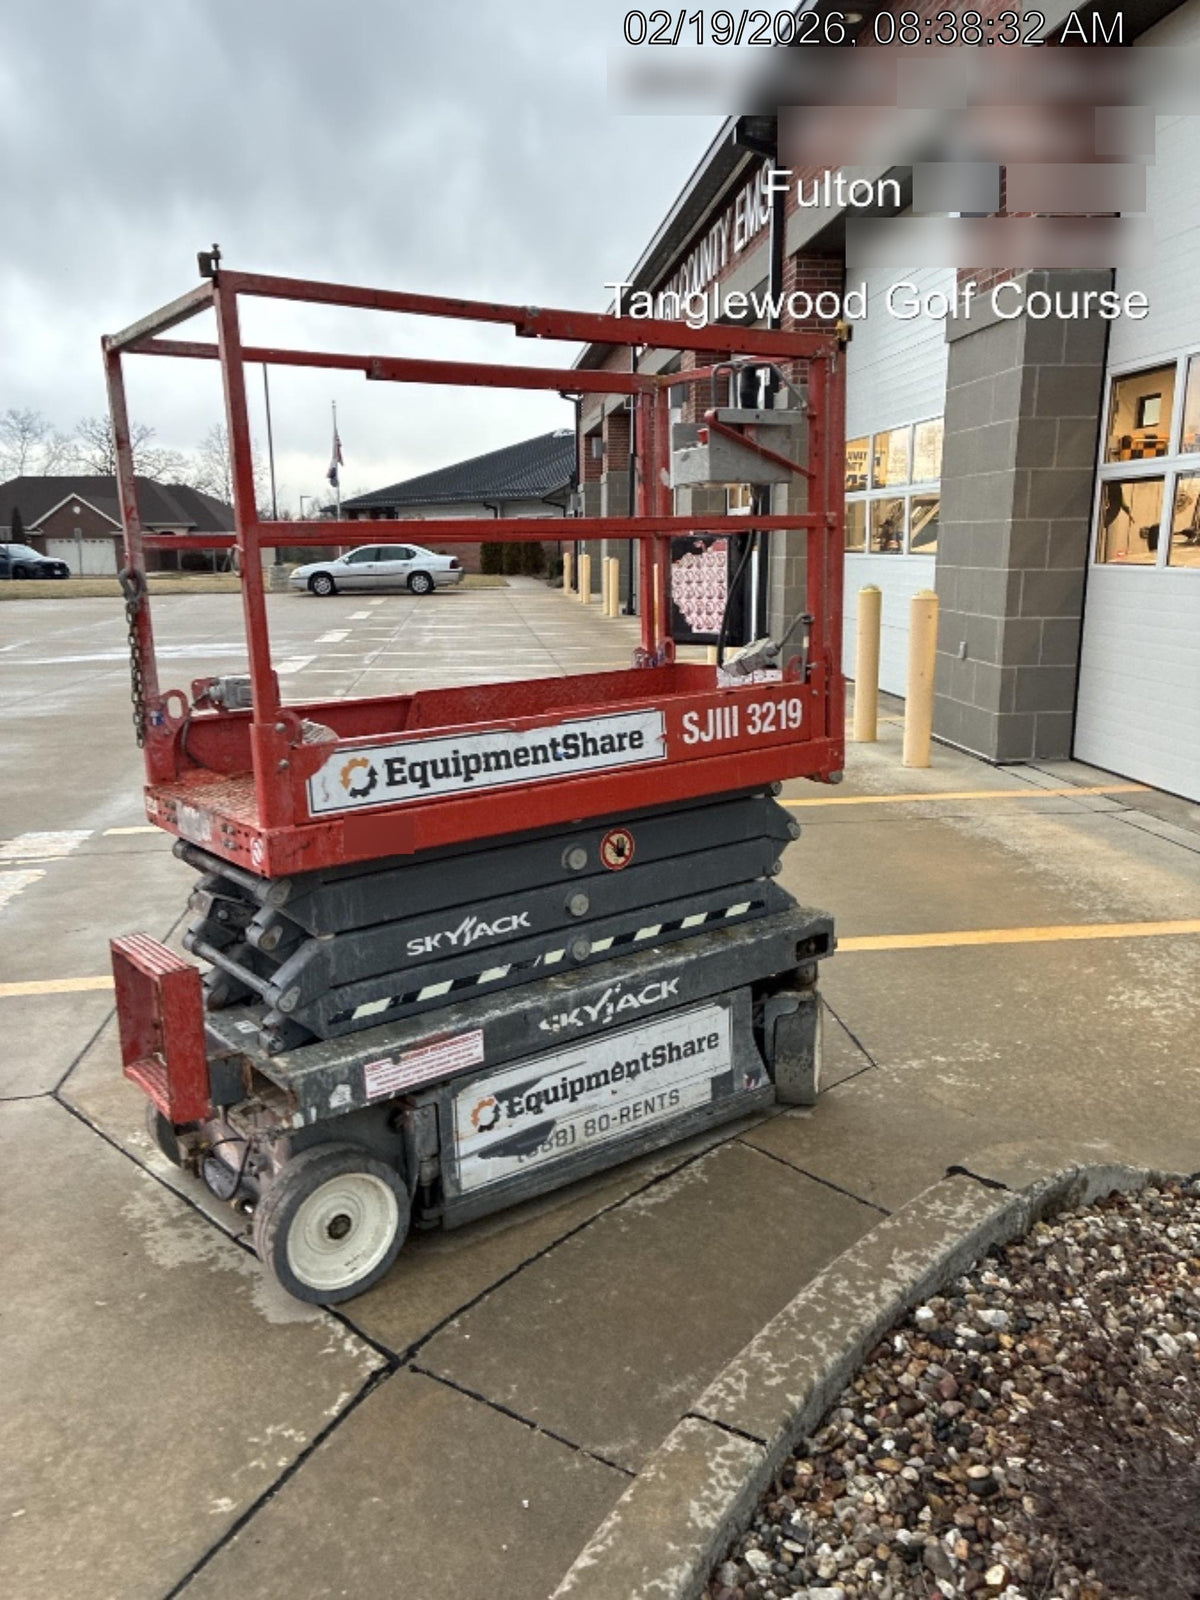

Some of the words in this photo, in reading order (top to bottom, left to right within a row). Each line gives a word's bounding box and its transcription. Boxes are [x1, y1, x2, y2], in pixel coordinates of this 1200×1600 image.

[681, 705, 740, 745] SJIII
[746, 697, 803, 736] 3219
[384, 728, 645, 789] EquipmentShare
[406, 911, 532, 956] SKYJACK
[506, 1031, 719, 1119] EquipmentShare
[583, 1088, 680, 1138] 80-RENTS
